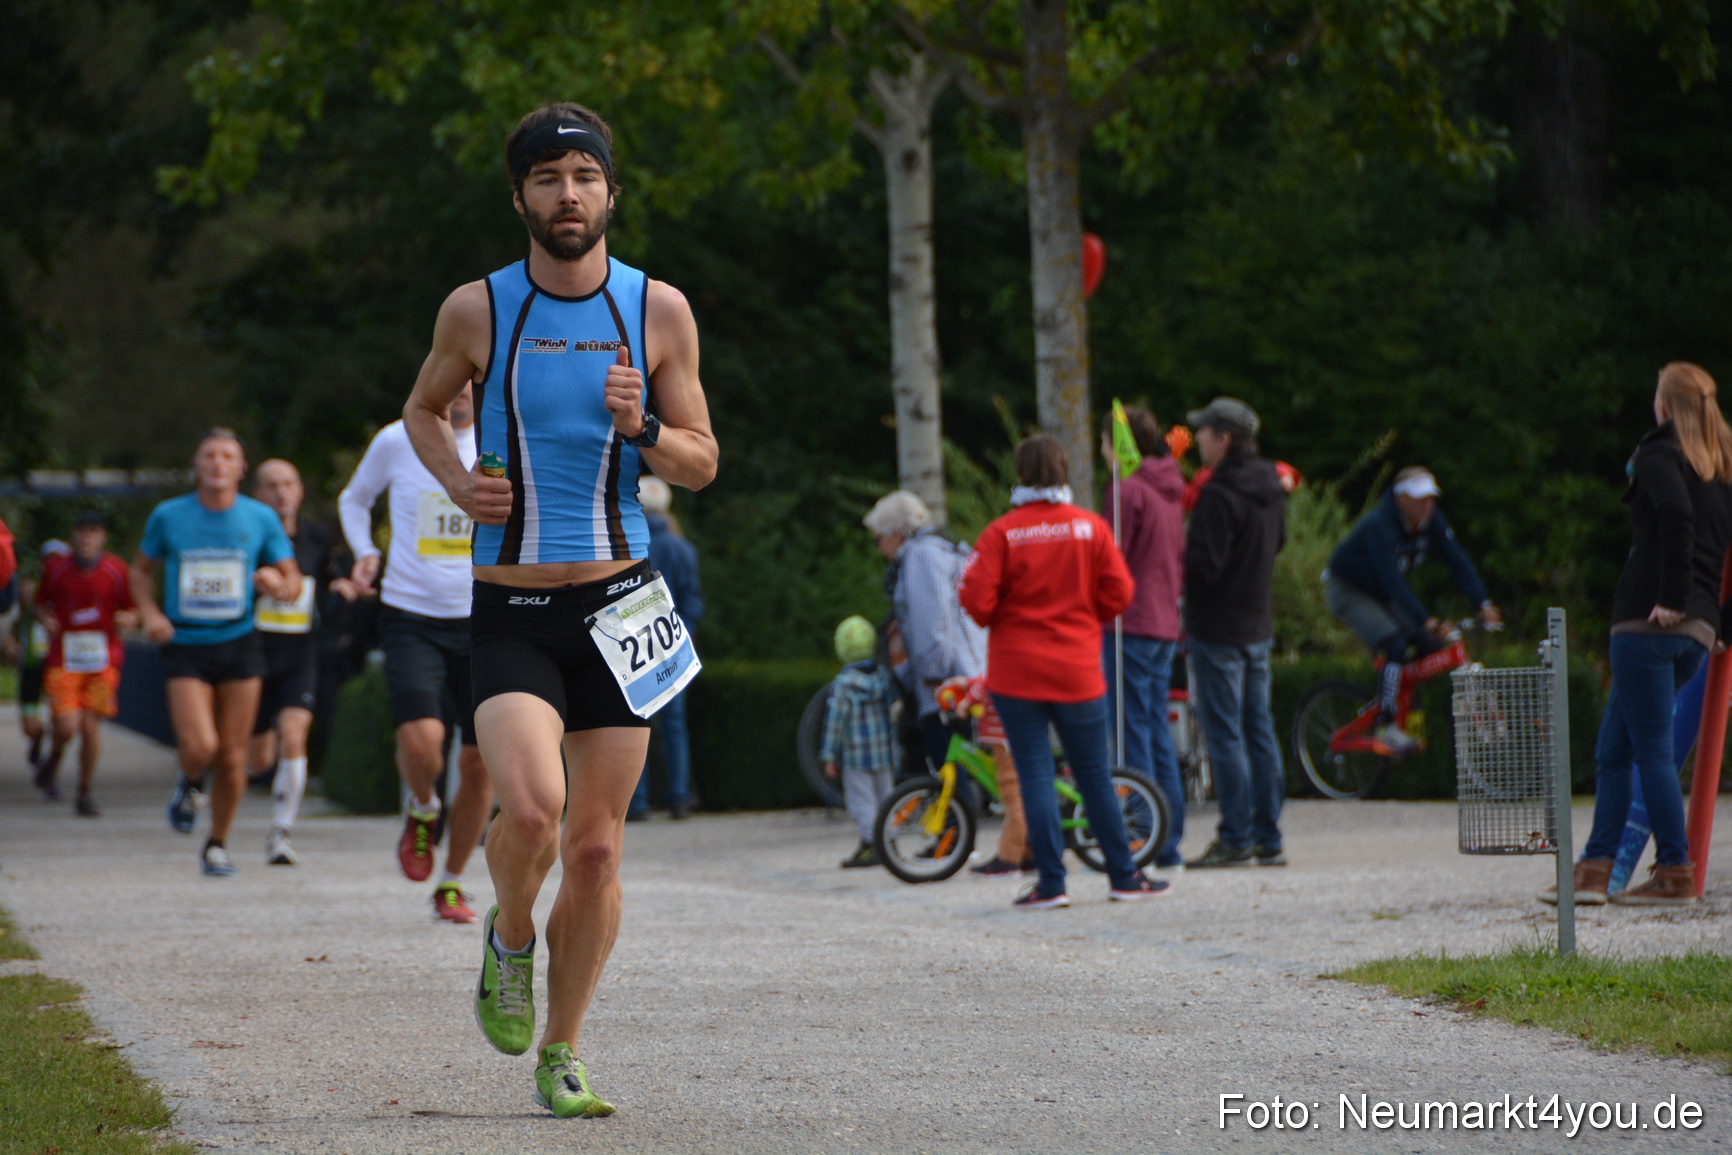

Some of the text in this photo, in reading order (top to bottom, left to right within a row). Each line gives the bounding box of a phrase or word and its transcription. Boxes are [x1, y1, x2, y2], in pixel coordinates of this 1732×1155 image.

[575, 341, 588, 351] BIO
[1006, 522, 1071, 542] raumbox
[606, 575, 641, 595] 2XU
[508, 596, 550, 605] 2XU
[630, 589, 666, 615] BOCK
[620, 607, 682, 672] 2709
